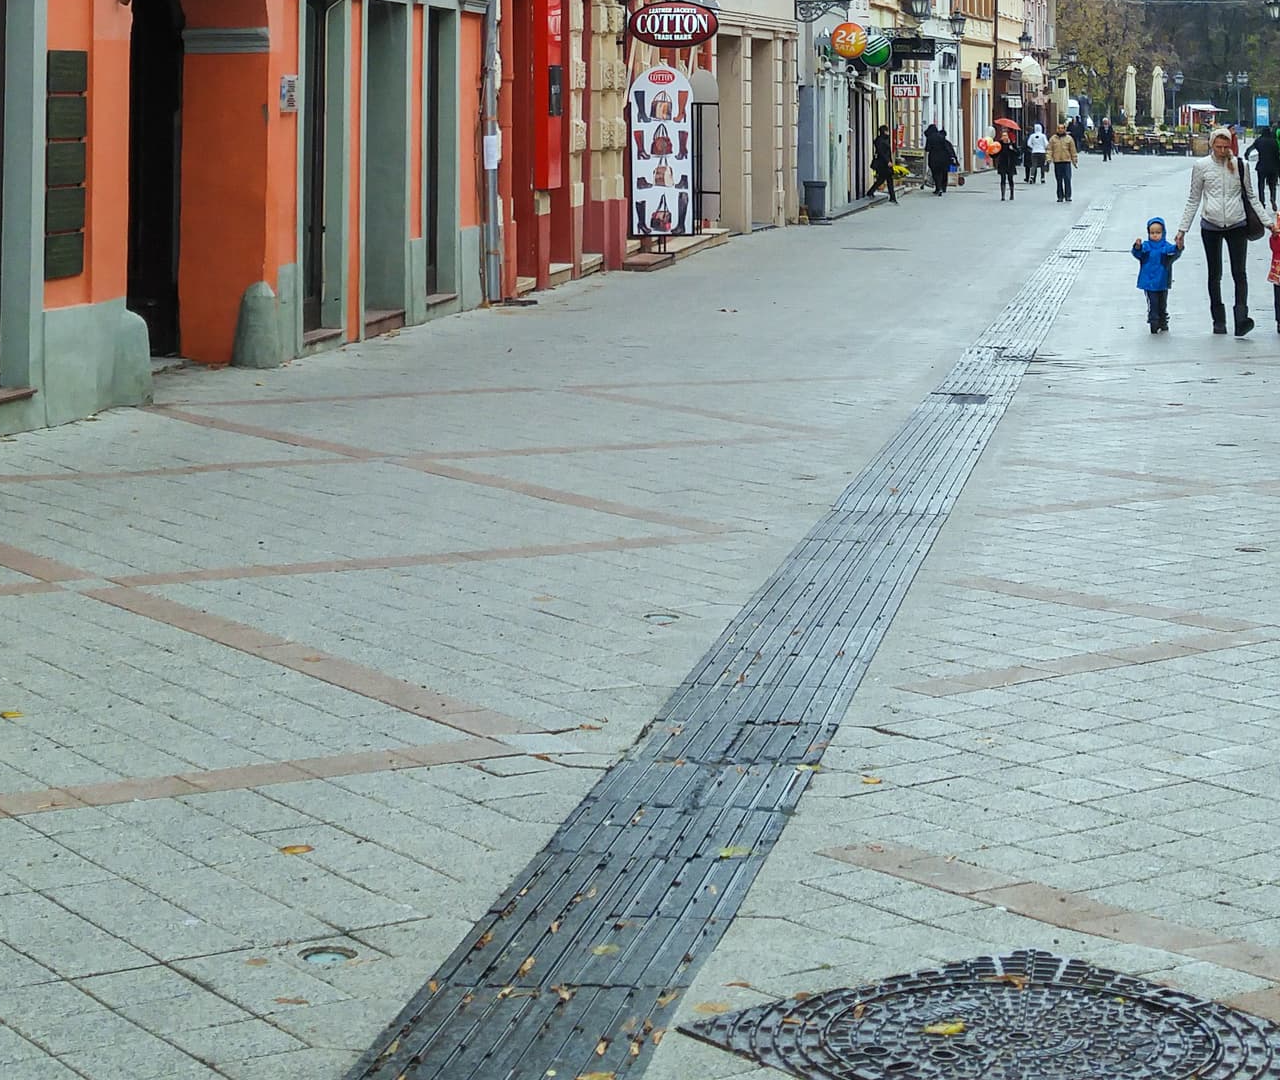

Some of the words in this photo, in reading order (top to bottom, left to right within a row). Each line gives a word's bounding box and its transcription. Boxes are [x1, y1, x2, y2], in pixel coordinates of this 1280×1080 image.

[636, 13, 709, 34] COTTON
[835, 30, 857, 45] 24
[834, 44, 856, 52] SATA
[650, 73, 673, 81] COTTON
[893, 74, 918, 85] ДЕЧЈА
